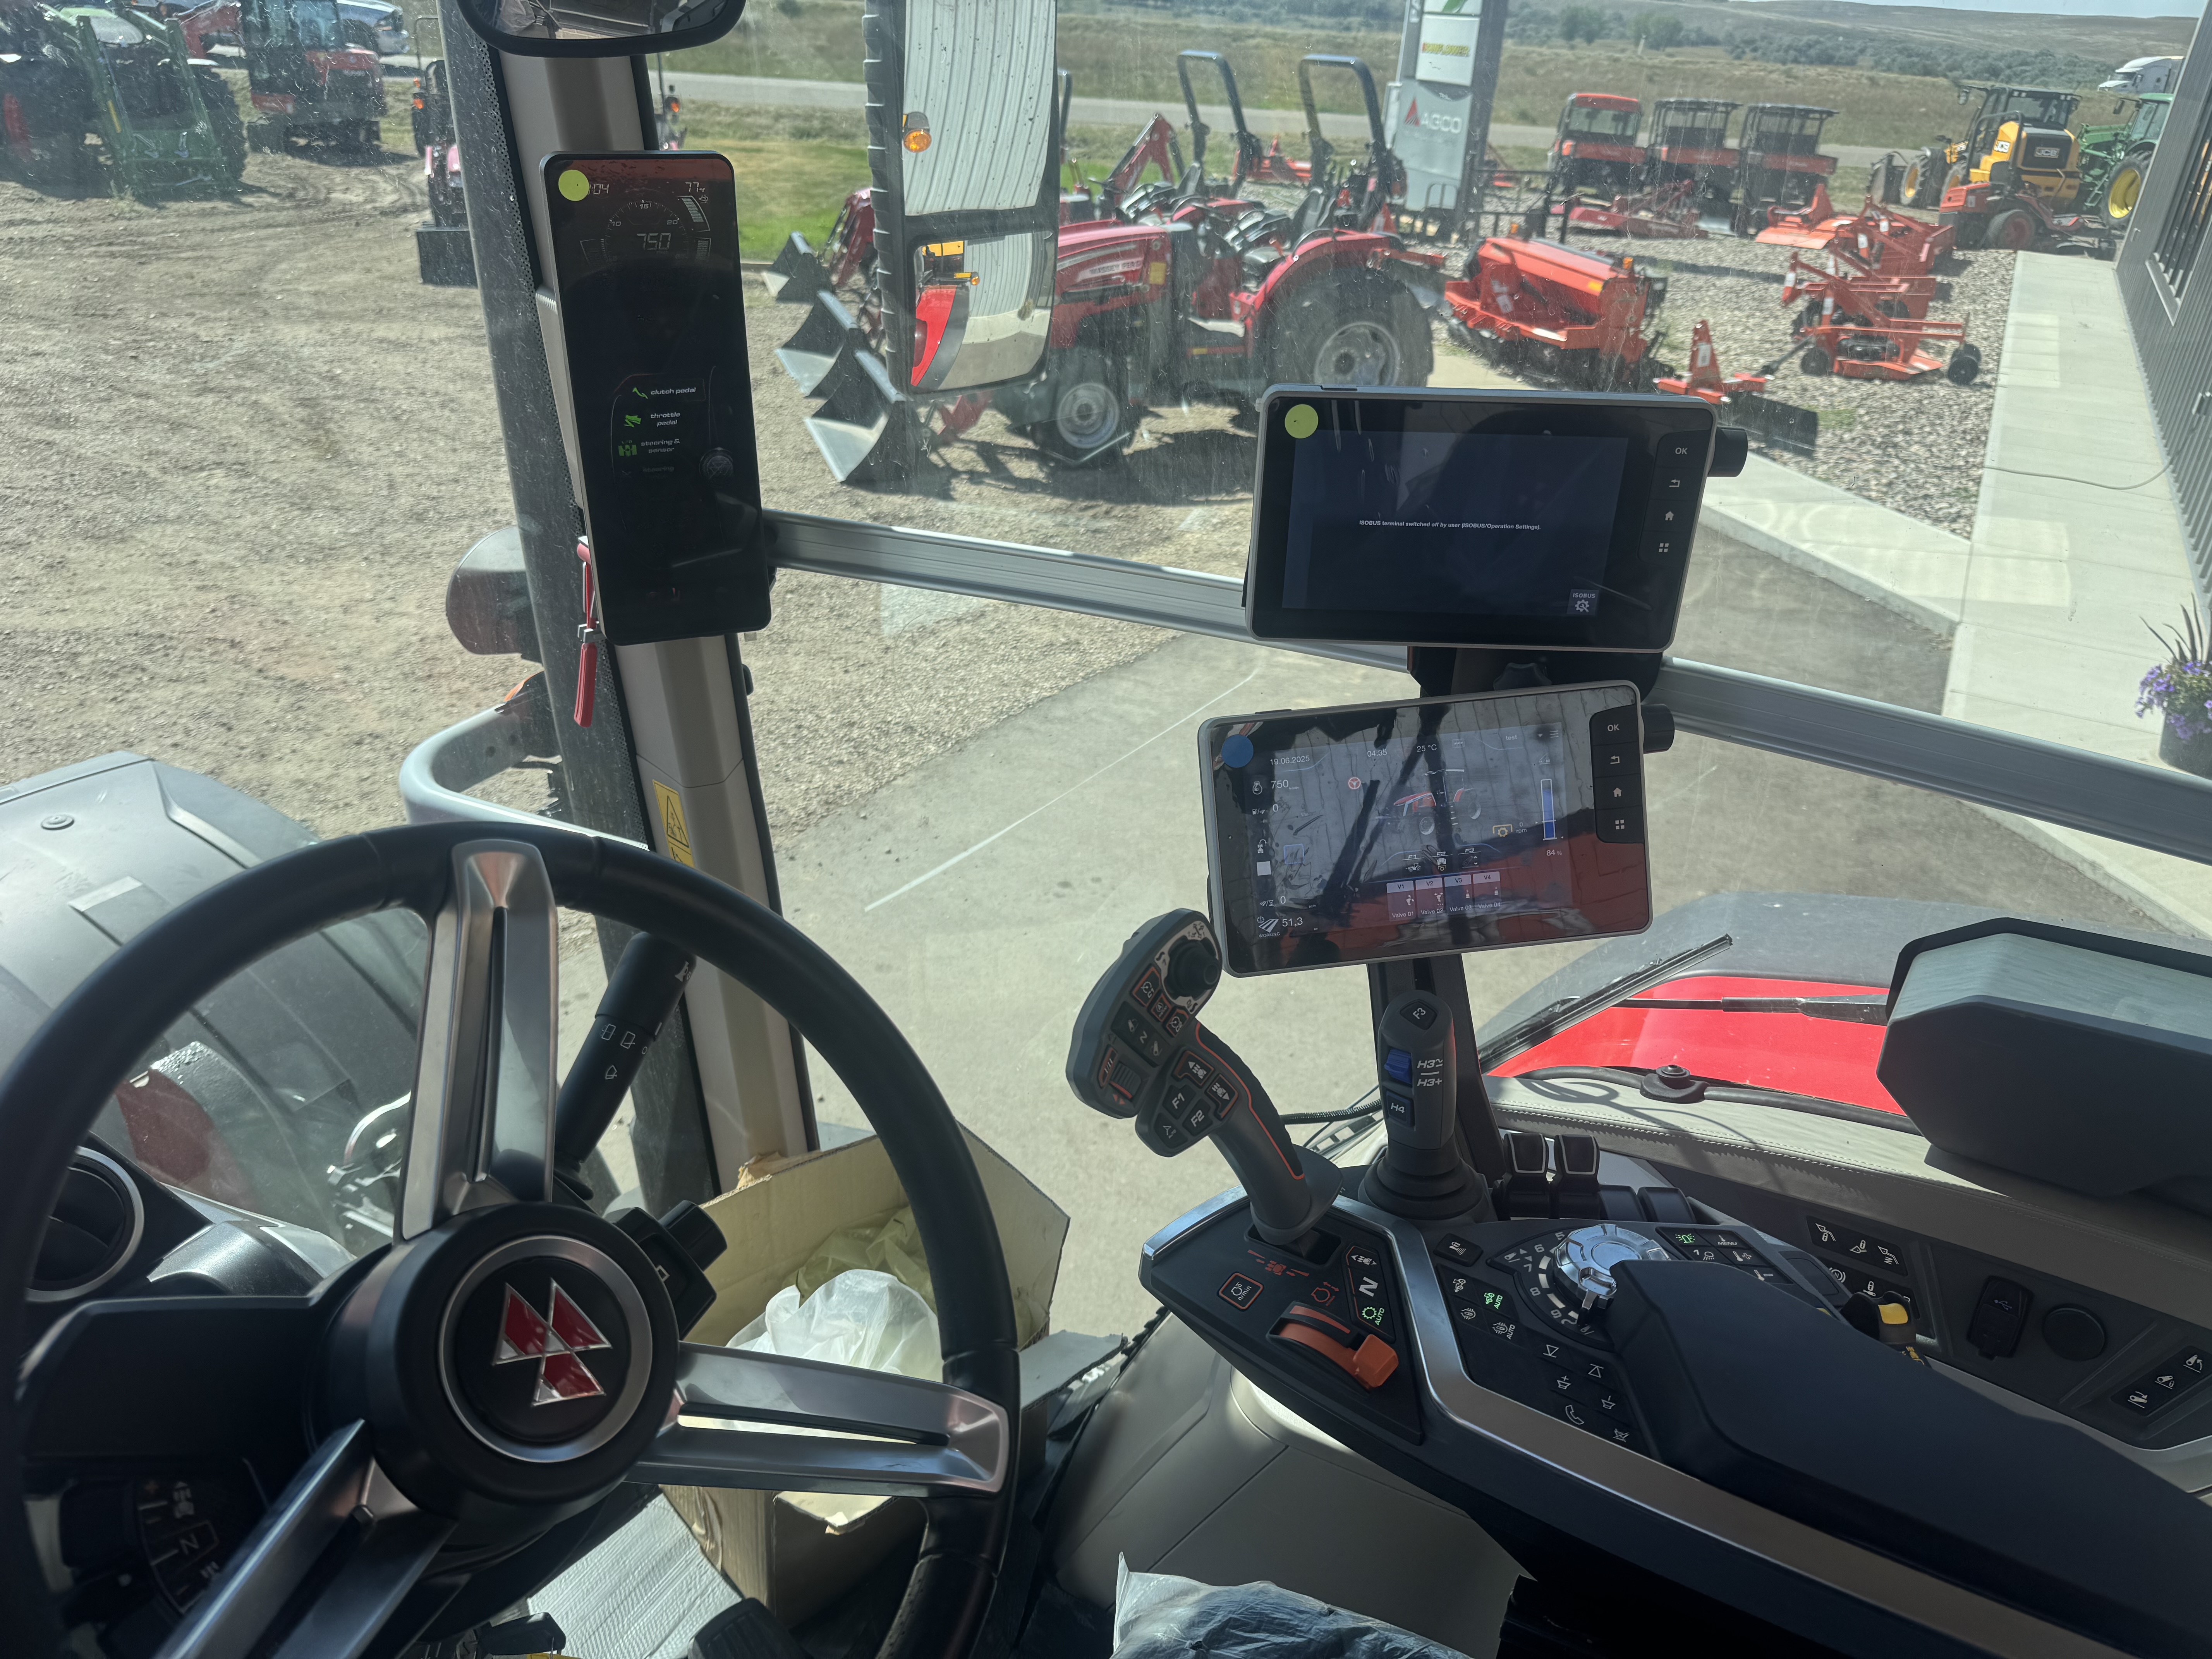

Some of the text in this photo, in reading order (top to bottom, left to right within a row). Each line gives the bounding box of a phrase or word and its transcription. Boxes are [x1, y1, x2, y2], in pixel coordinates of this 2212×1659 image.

[1421, 113, 1462, 134] AGCO
[637, 233, 672, 251] 750
[1270, 756, 1310, 765] 19.06.2025
[1271, 780, 1289, 789] 750
[1273, 804, 1278, 812] 0
[1282, 917, 1303, 927] 51,3
[1413, 1008, 1426, 1019] F3
[1140, 1030, 1148, 1044] N
[1417, 1078, 1442, 1087] H3+
[1172, 1092, 1185, 1109] F1
[1391, 1103, 1405, 1113] H4
[1190, 1110, 1205, 1127] F2
[1168, 1129, 1177, 1139] AUTO
[1555, 1231, 1565, 1240] 5
[1534, 1244, 1545, 1253] 6
[1523, 1263, 1532, 1272] 7
[1358, 1277, 1378, 1297] N
[1529, 1287, 1541, 1296] 8
[1237, 1285, 1252, 1301] n/min
[1494, 1295, 1503, 1310] AUTO
[1374, 1307, 1385, 1326] AUTO
[1550, 1309, 1562, 1318] 9
[1506, 1324, 1516, 1340] AUTO
[180, 1534, 199, 1555] N
